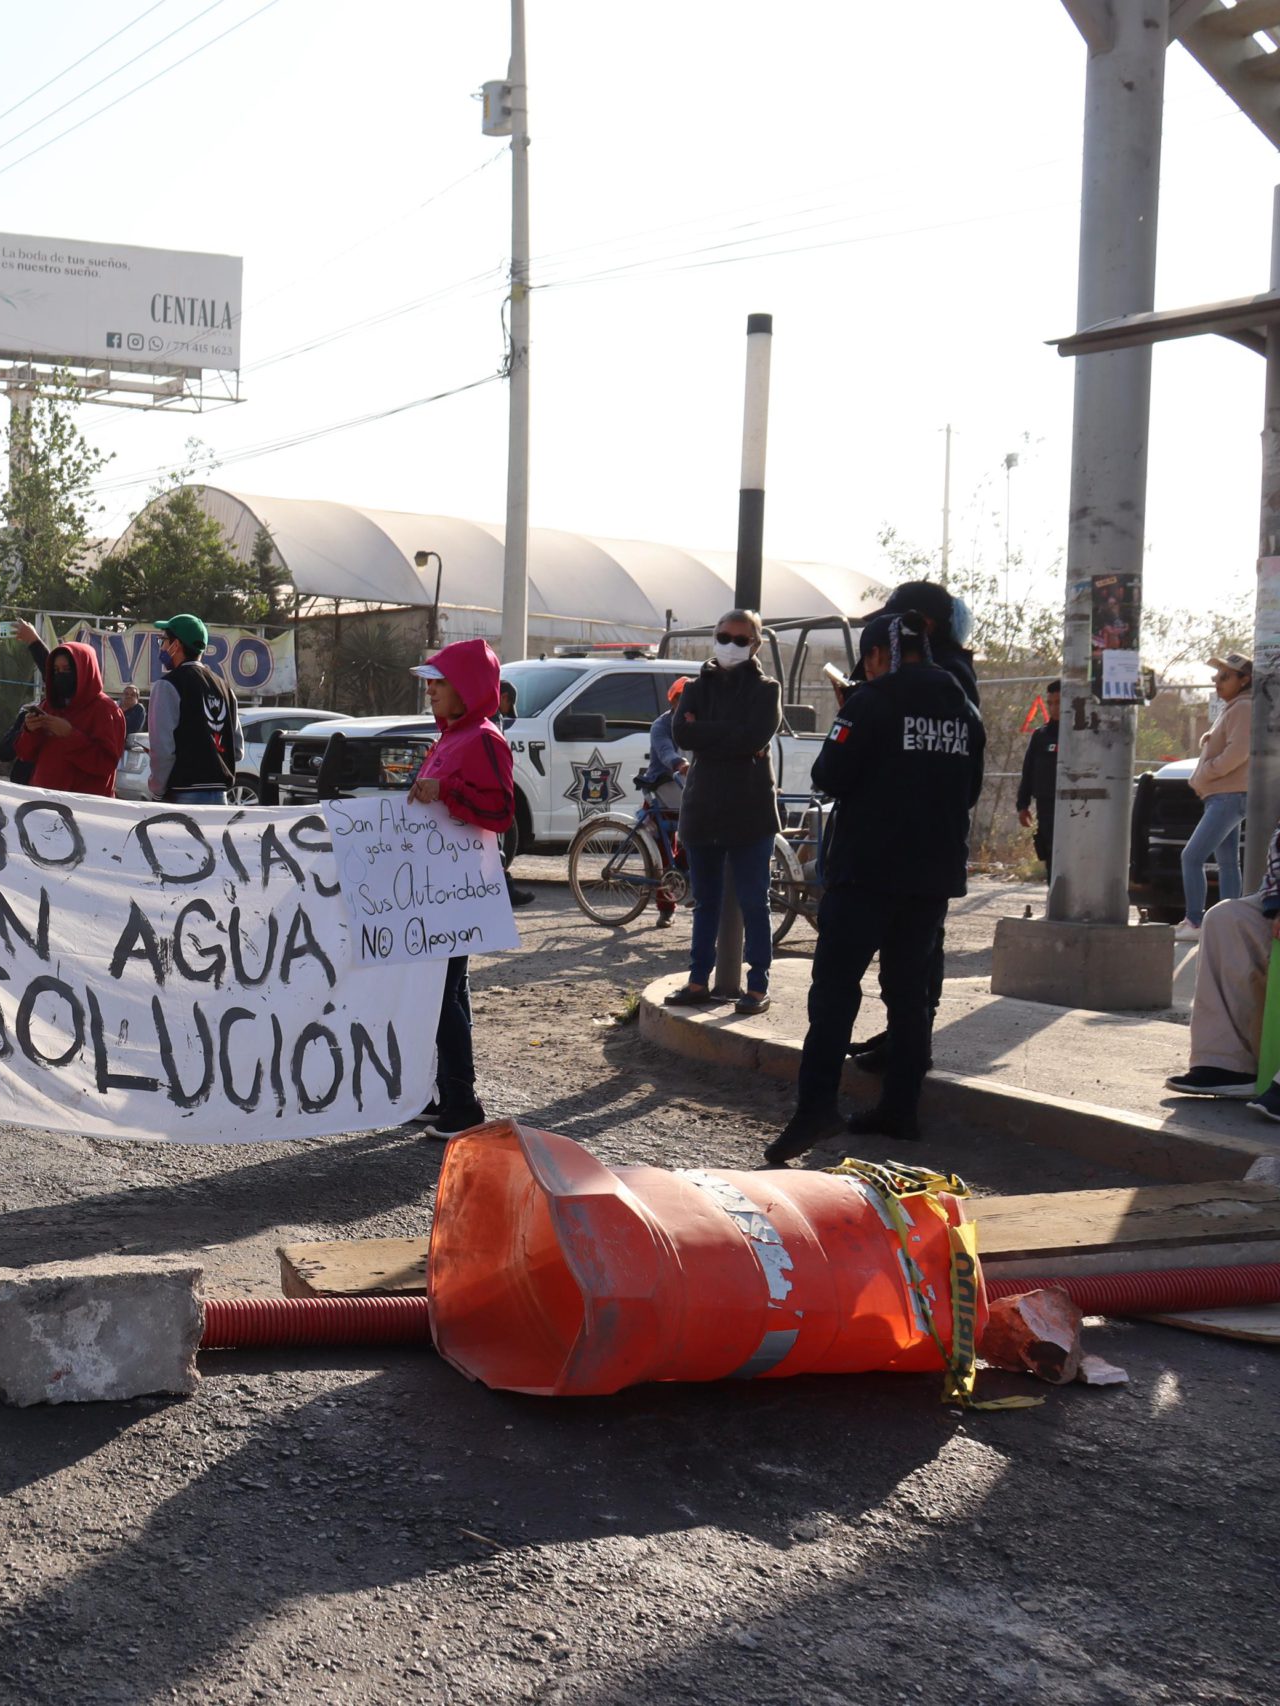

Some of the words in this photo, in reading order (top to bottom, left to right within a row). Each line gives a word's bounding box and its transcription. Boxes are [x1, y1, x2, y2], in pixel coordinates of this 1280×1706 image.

[1, 247, 15, 259] La
[18, 247, 47, 261] boda
[50, 251, 65, 263] de
[67, 254, 85, 265] tus
[1, 260, 15, 270] es
[17, 261, 61, 274] nuestro
[150, 292, 233, 330] CENTALA
[75, 629, 274, 688] IVRO
[903, 716, 970, 739] POLICÍA
[903, 734, 970, 756] ESTATAL
[329, 798, 373, 835] San
[380, 798, 437, 835] Antonio
[365, 838, 393, 864] gota
[400, 837, 416, 853] de
[358, 884, 392, 915] Sus
[108, 899, 336, 989] AGUA
[362, 923, 393, 960] NO
